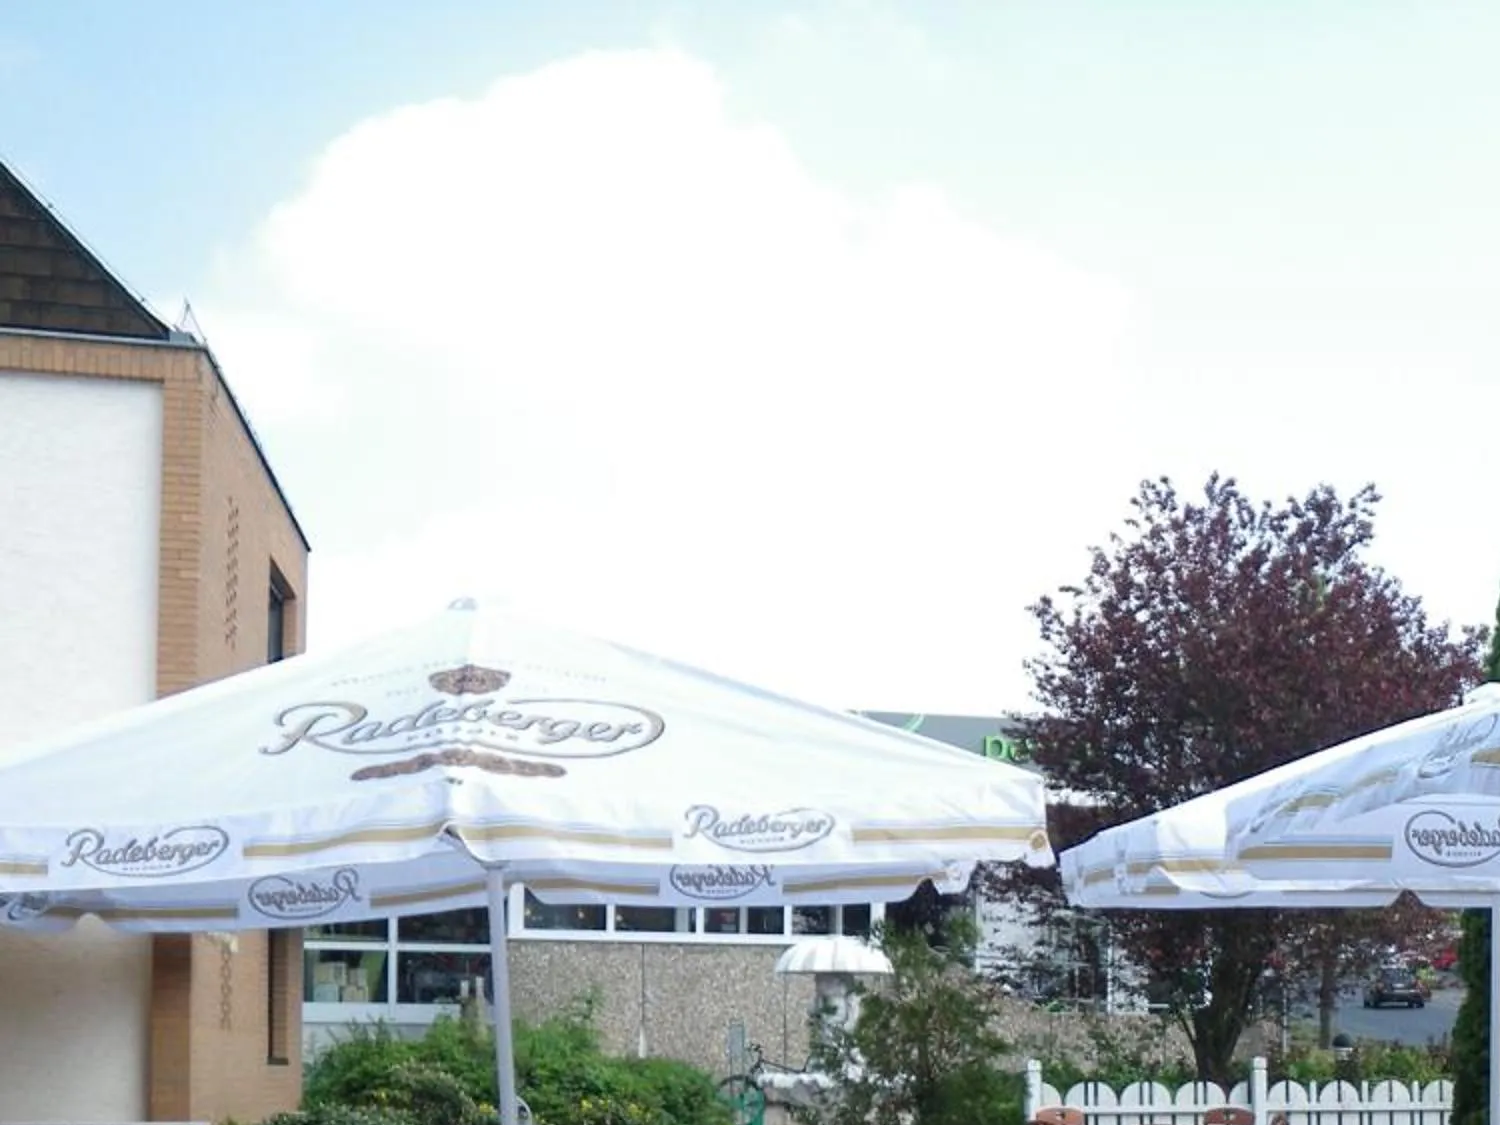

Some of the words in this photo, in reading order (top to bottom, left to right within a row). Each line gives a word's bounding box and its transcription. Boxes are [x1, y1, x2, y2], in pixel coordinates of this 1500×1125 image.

[259, 697, 666, 758] Radeberger
[61, 825, 229, 877] Radeberger
[683, 804, 835, 852] Radeberger
